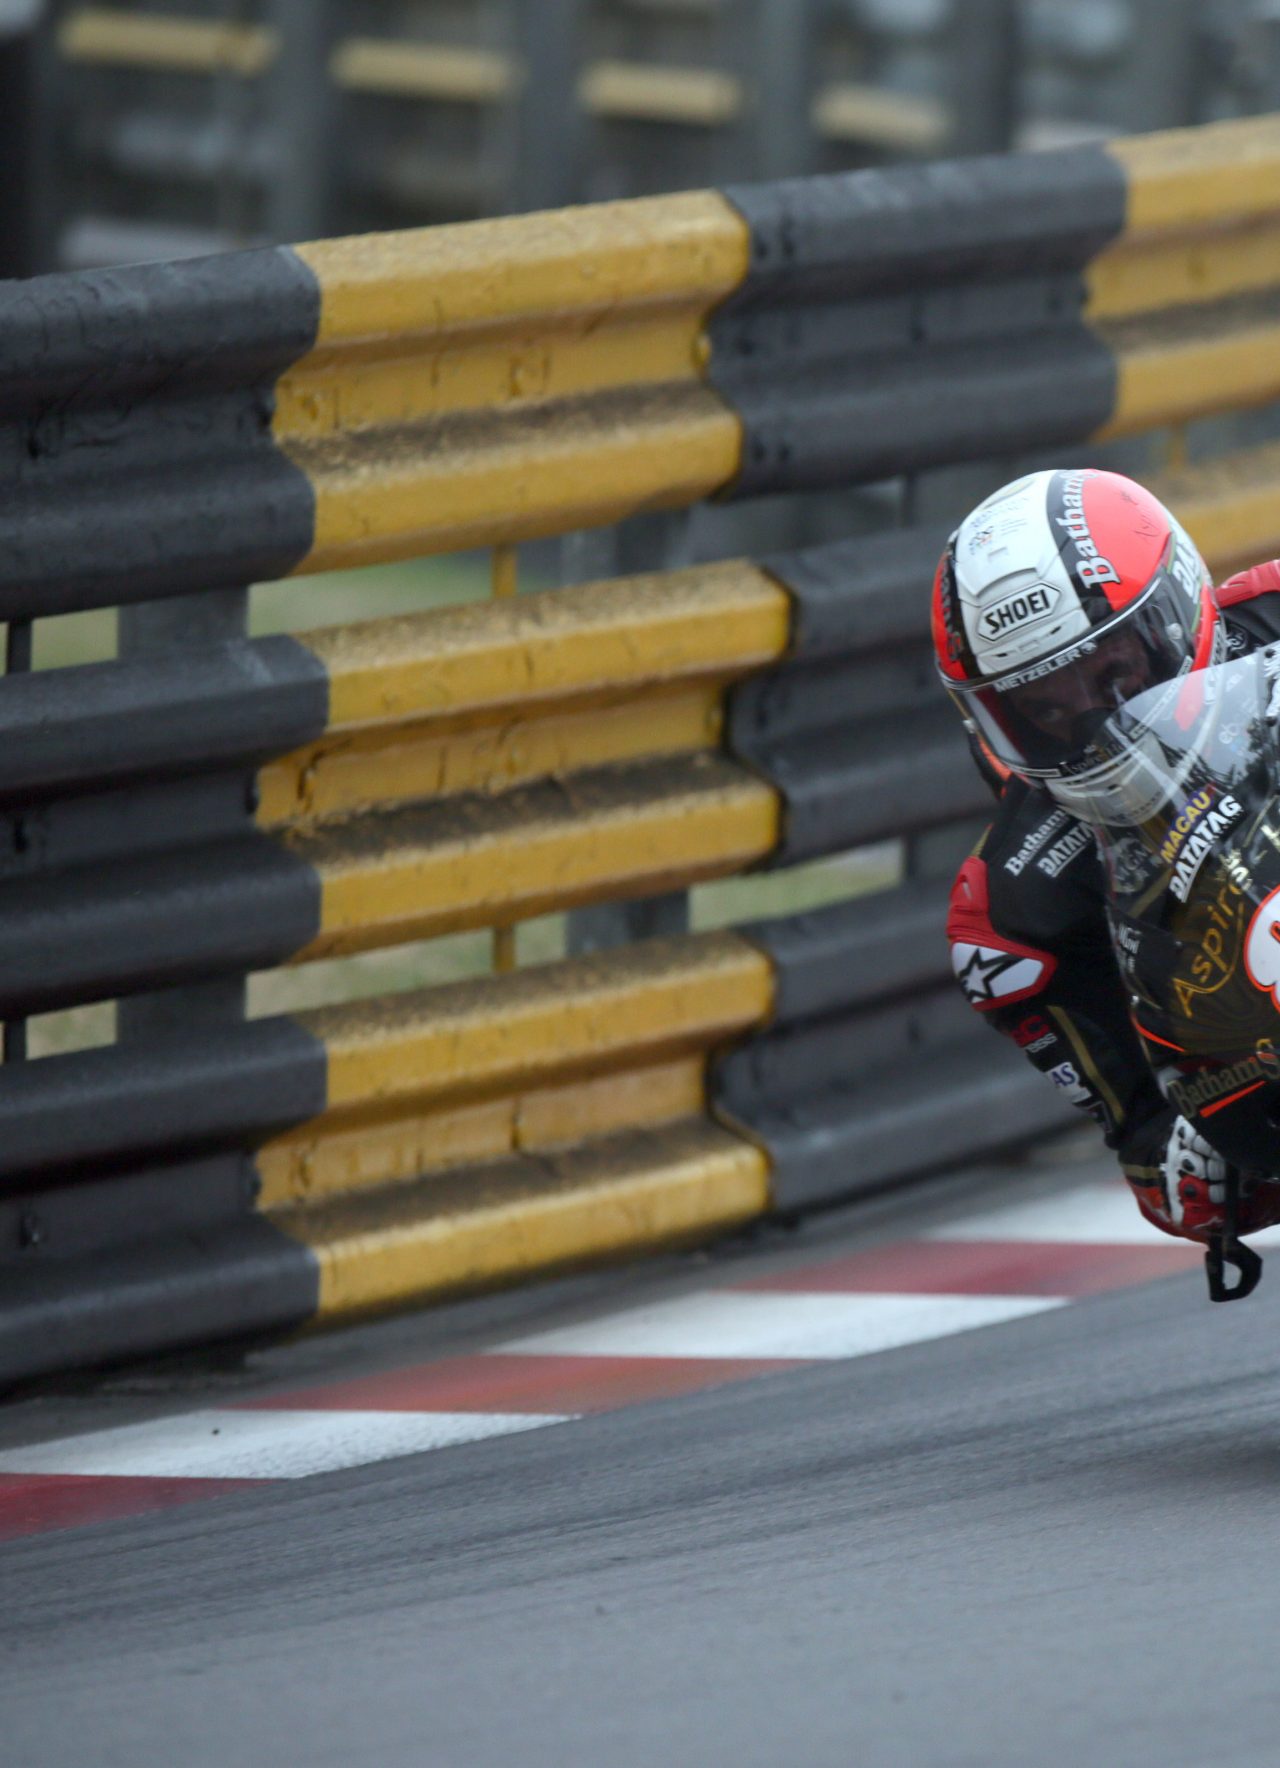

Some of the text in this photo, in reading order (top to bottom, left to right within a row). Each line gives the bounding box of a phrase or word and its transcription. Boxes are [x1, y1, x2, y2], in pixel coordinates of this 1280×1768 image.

[984, 589, 1050, 634] SHOEI
[993, 650, 1082, 692] METZELER
[1004, 808, 1073, 877] Batham
[1160, 791, 1213, 863] MACAU
[1168, 795, 1243, 898] DATATAG
